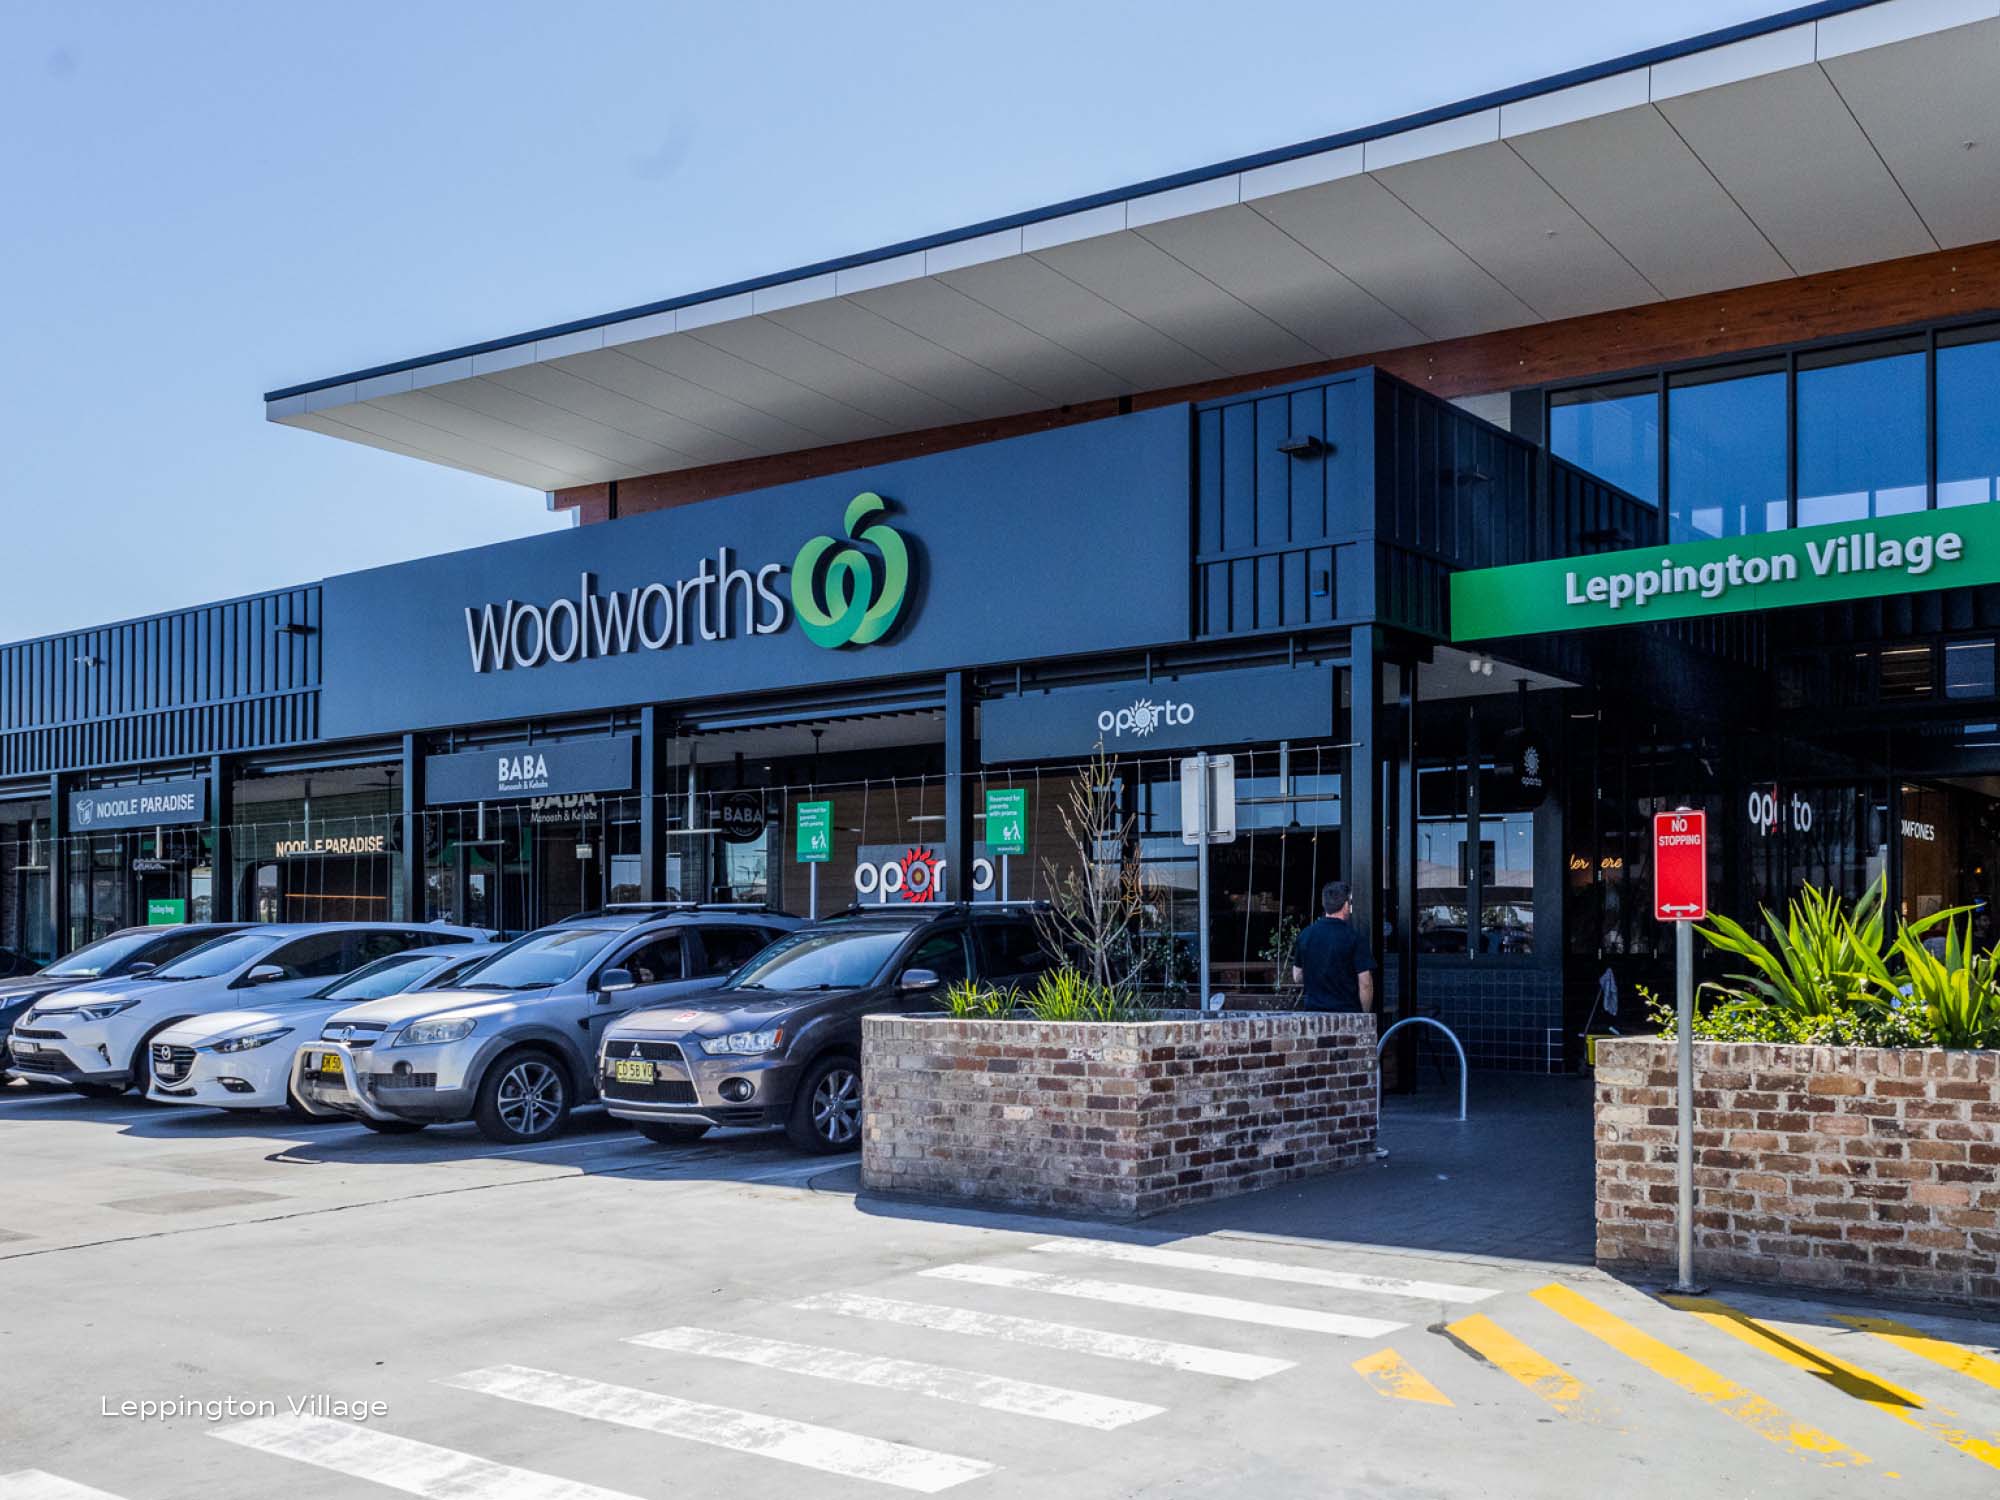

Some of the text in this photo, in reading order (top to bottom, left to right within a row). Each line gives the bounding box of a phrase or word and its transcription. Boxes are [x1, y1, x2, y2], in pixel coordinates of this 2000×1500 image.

[1566, 531, 1963, 608] Leppington Village
[1097, 697, 1195, 737] oporto
[498, 753, 548, 781] BABA
[96, 793, 195, 818] NOODLE PARADISE
[723, 806, 763, 823] BABA
[1671, 818, 1688, 832] NO
[325, 835, 384, 853] PARADISE
[1659, 834, 1701, 846] STOPPING
